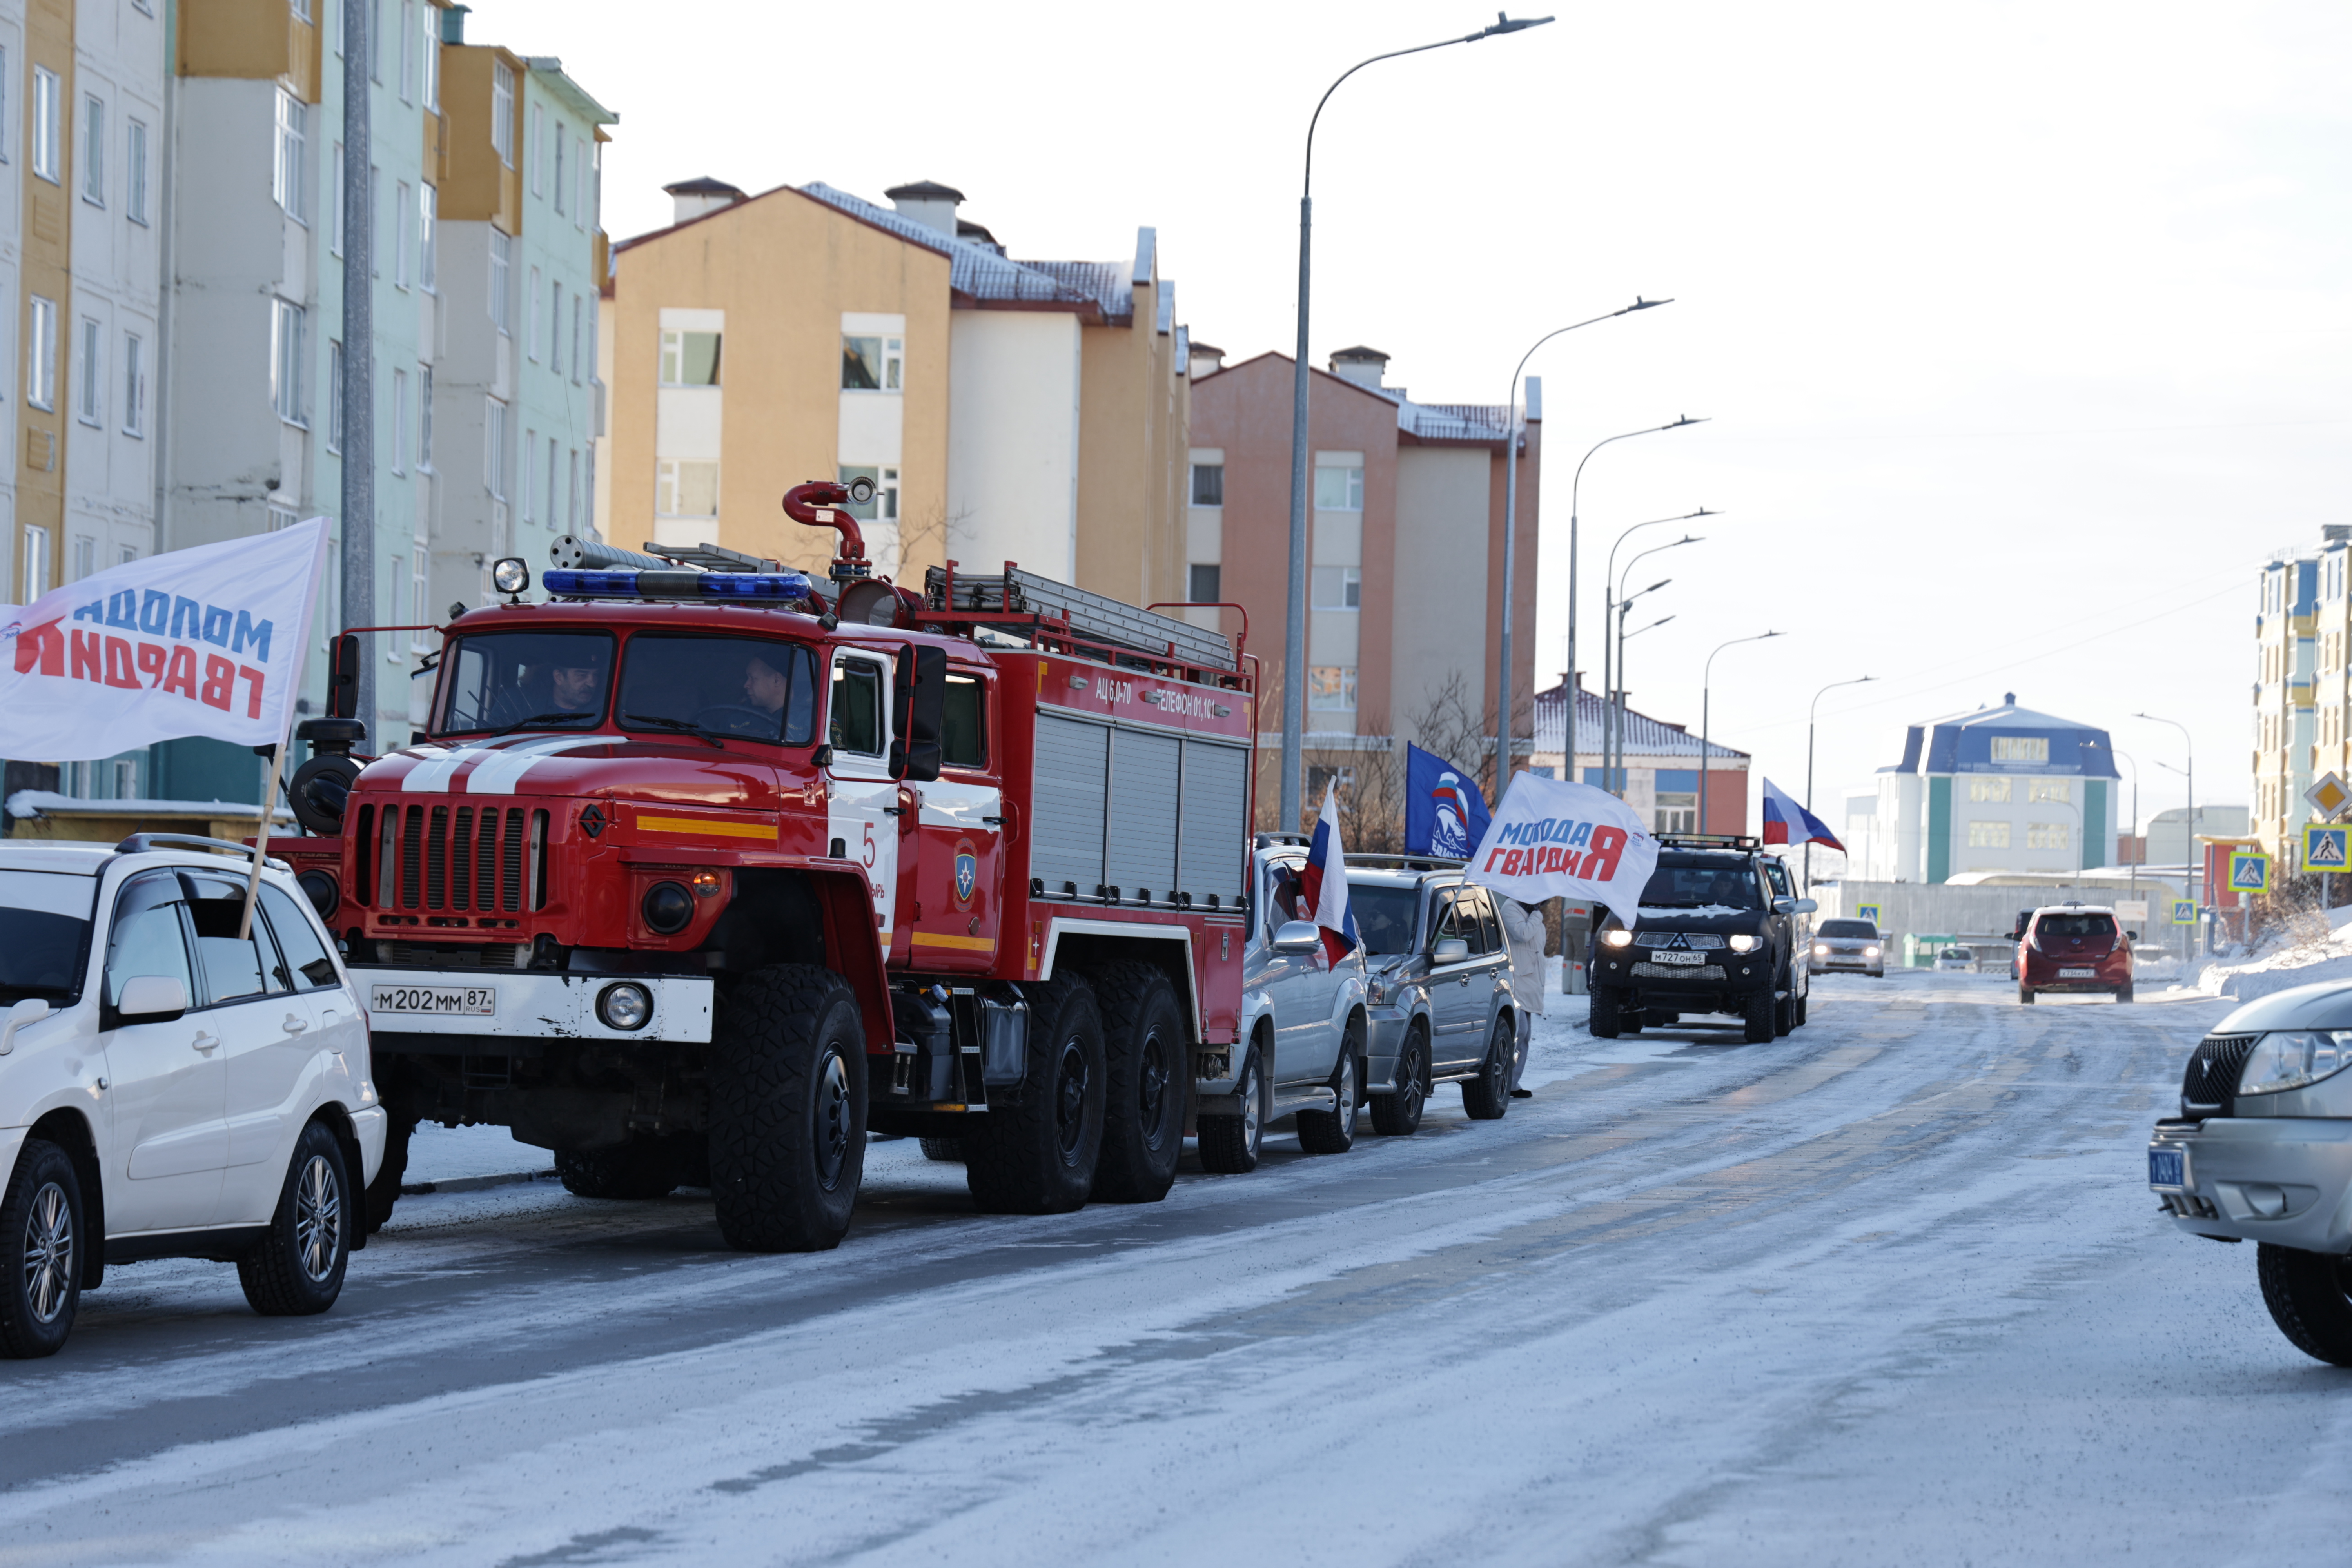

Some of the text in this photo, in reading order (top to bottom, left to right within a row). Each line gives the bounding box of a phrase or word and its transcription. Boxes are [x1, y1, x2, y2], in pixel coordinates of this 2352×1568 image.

[1096, 677, 1131, 706] АЦ 6,0-70
[1157, 688, 1214, 722] ТЕЛЕФОН 01,101
[863, 822, 875, 869] 5
[1655, 953, 1691, 962] М727ОН
[380, 989, 487, 1011] М202ММ 87
